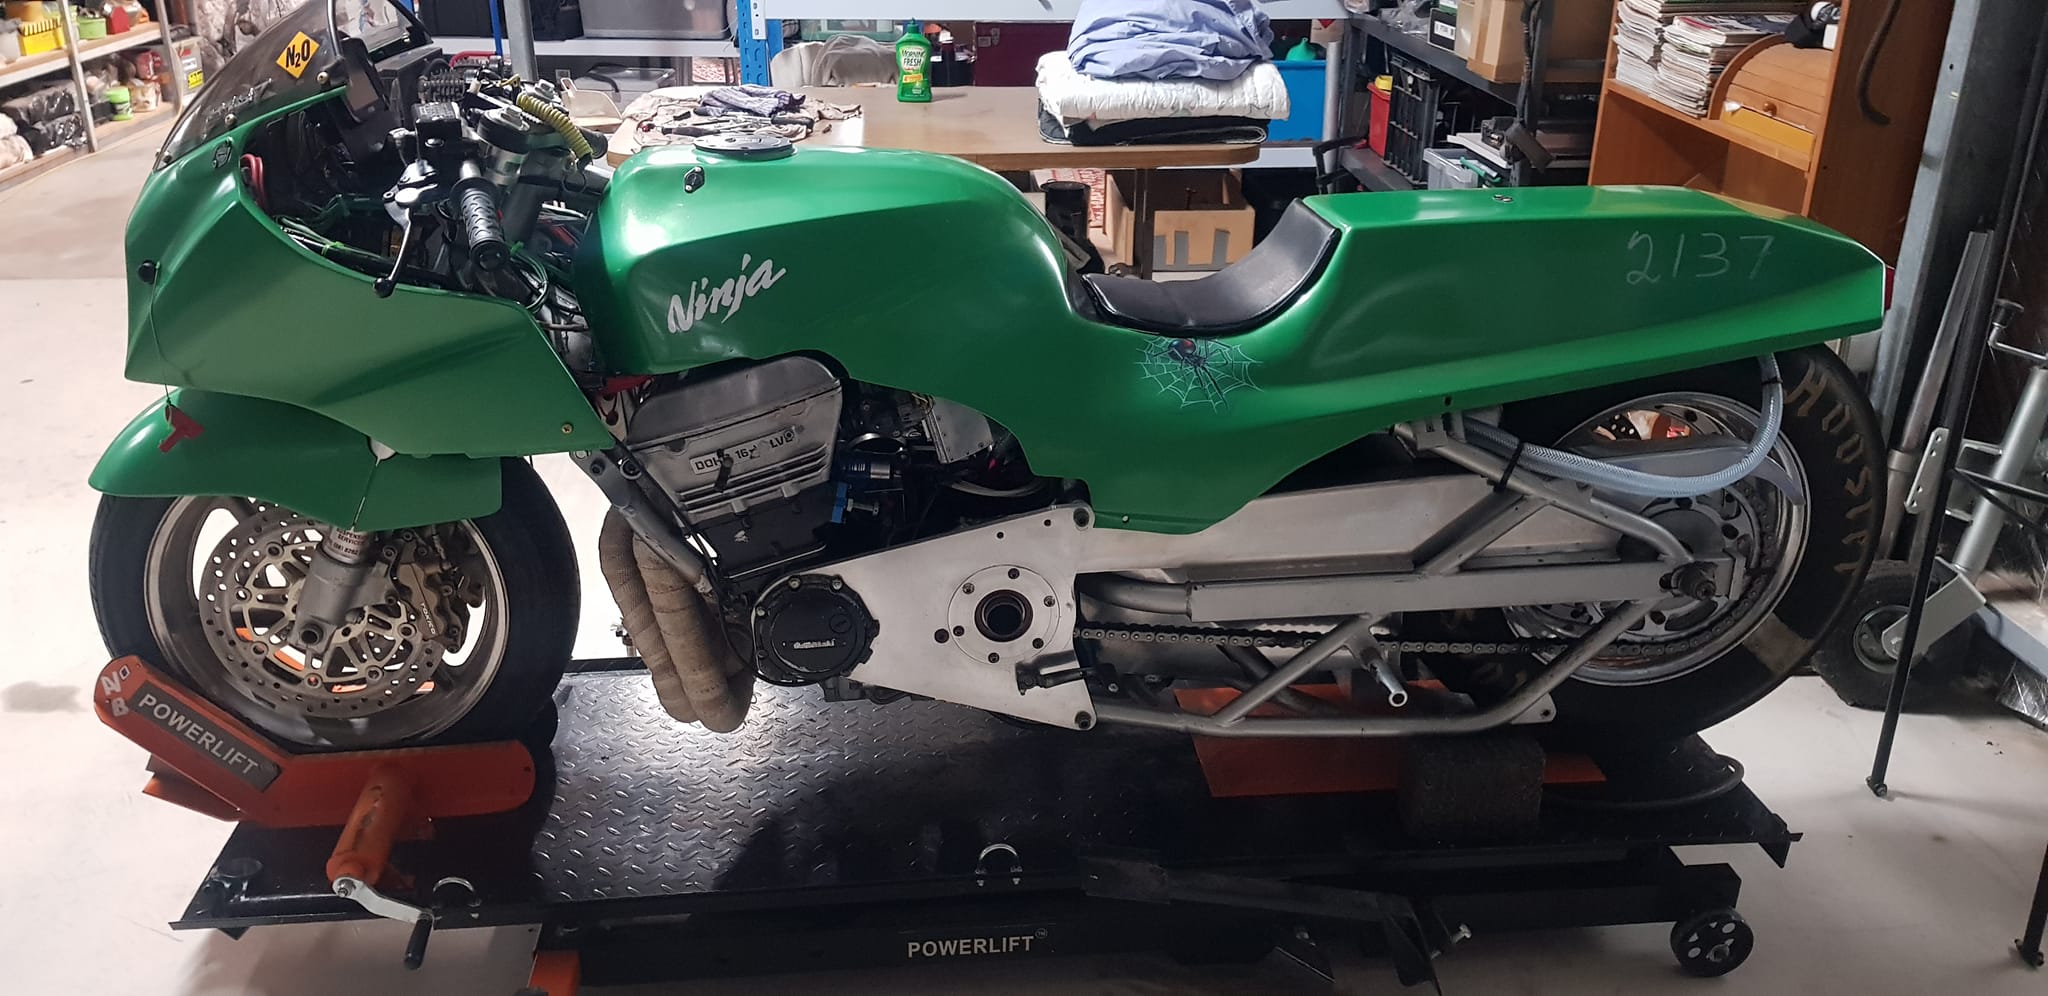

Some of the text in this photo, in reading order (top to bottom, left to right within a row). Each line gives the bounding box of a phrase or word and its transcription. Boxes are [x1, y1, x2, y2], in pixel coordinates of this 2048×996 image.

[1626, 231, 1774, 285] 2137
[668, 253, 787, 333] Ninja
[138, 693, 259, 775] POWERLIFT
[907, 935, 1035, 959] POWERLIFT
